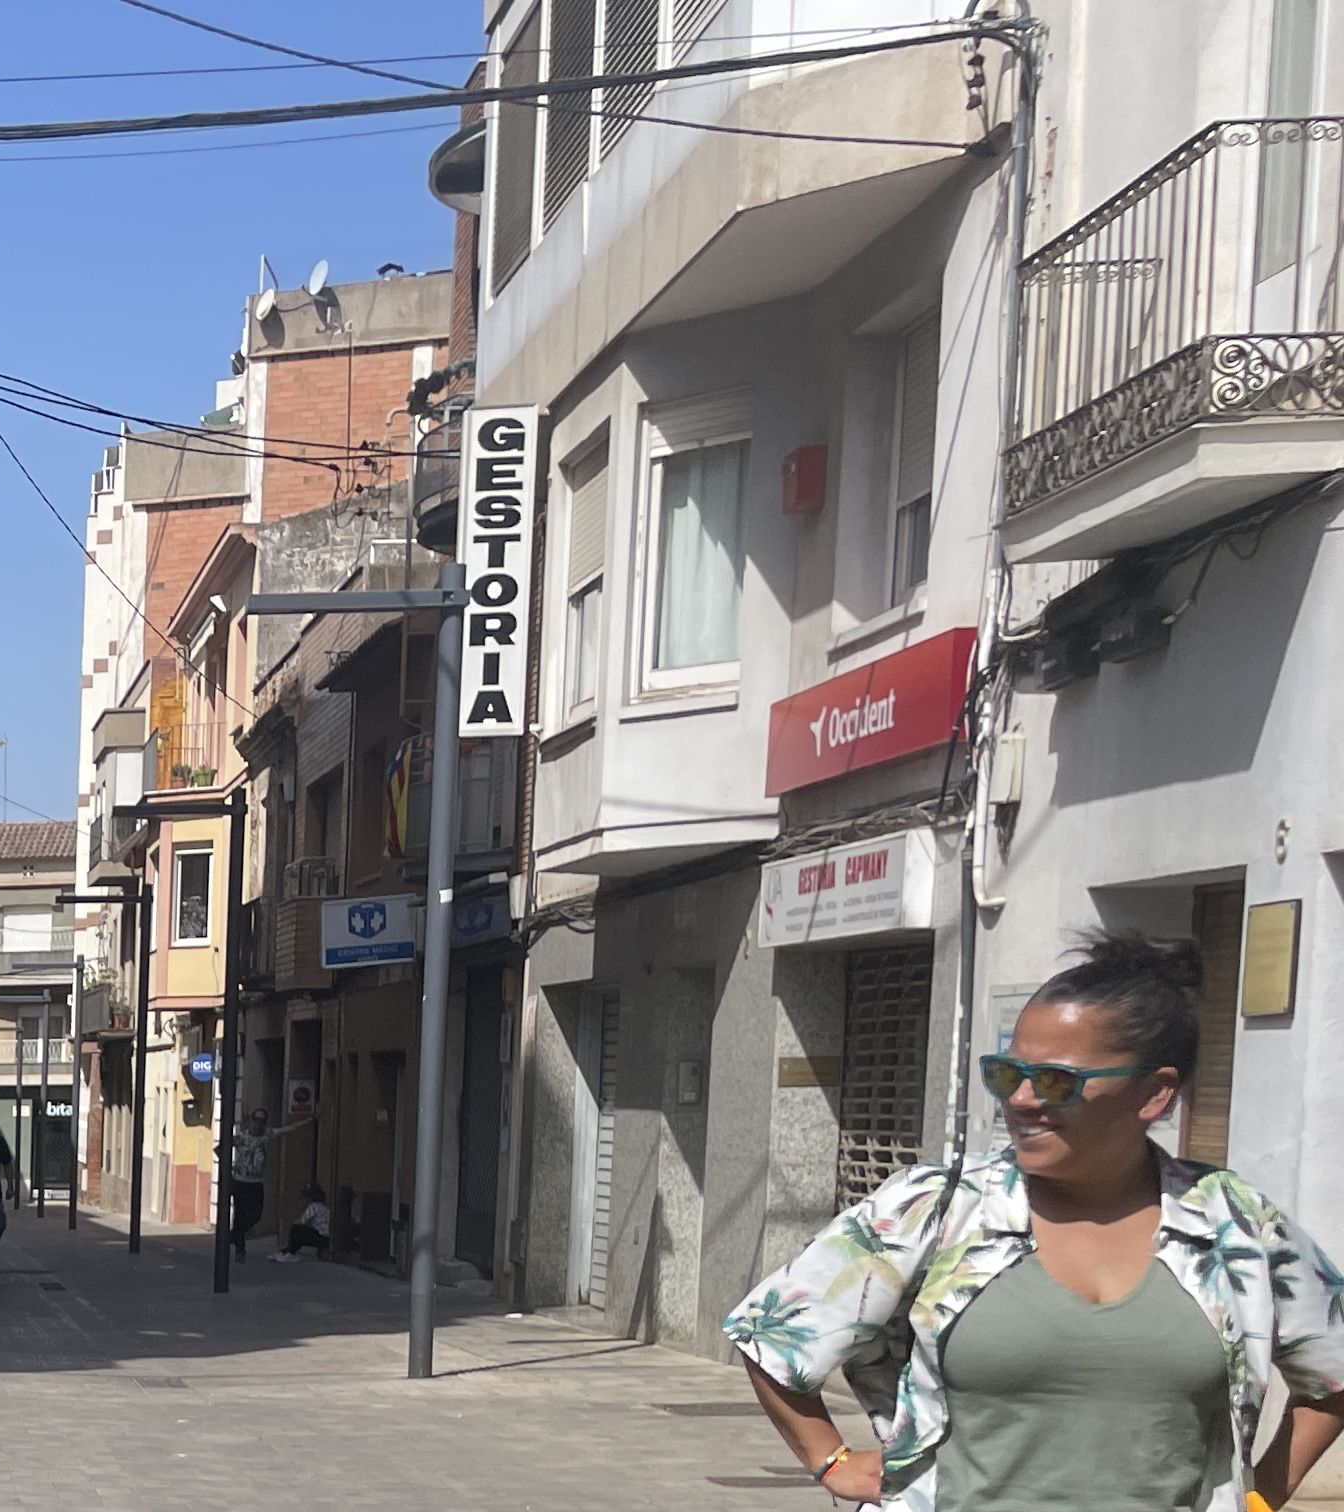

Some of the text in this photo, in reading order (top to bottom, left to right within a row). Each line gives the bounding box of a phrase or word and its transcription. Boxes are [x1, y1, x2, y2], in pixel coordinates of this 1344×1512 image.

[466, 417, 526, 724] GESTORIA
[828, 688, 896, 748] Occident
[192, 1061, 212, 1071] DIG
